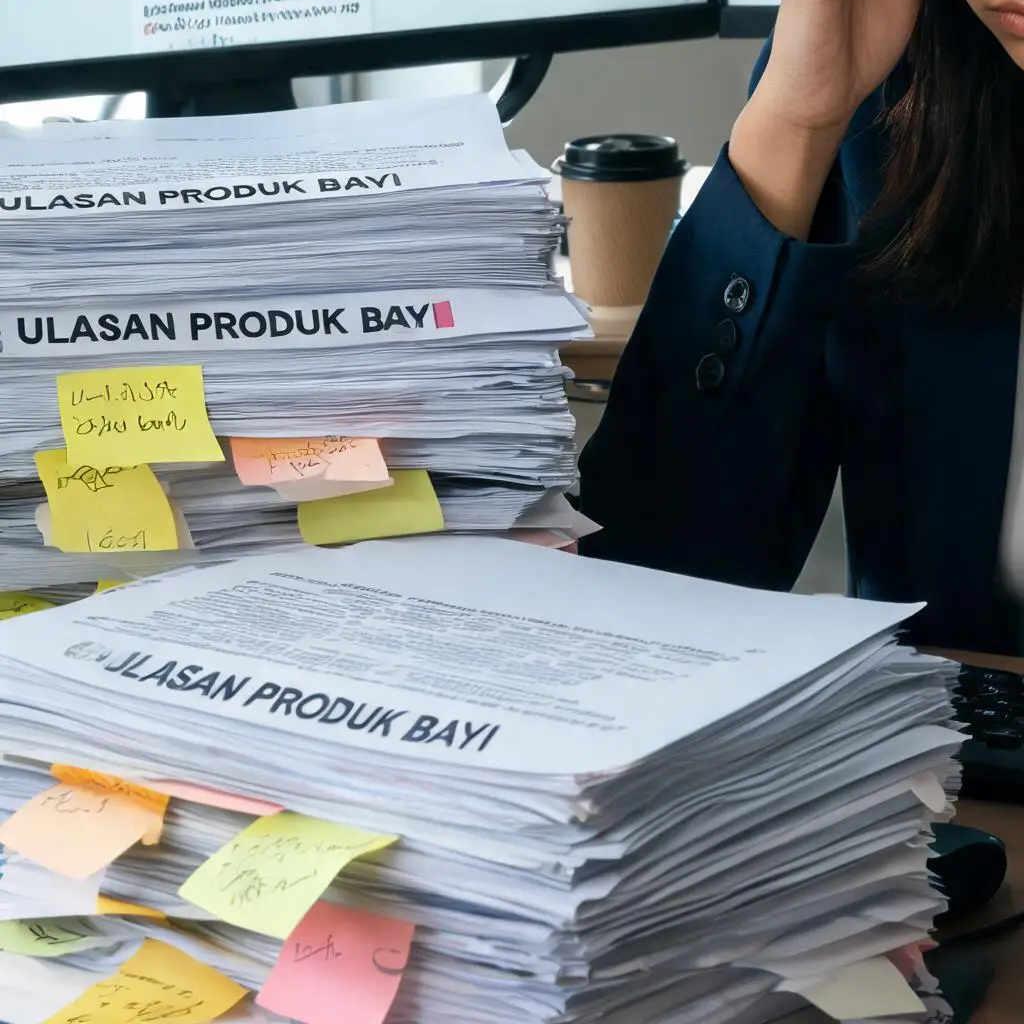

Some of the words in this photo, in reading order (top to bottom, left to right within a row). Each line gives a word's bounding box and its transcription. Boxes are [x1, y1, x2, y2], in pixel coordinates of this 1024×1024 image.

[0, 191, 147, 211] ULASAN
[158, 179, 307, 206] PRODUK
[17, 311, 176, 345] ULASAN
[189, 307, 350, 342] PRODUK
[243, 681, 409, 738] PRODUK
[401, 714, 500, 752] BAYI
